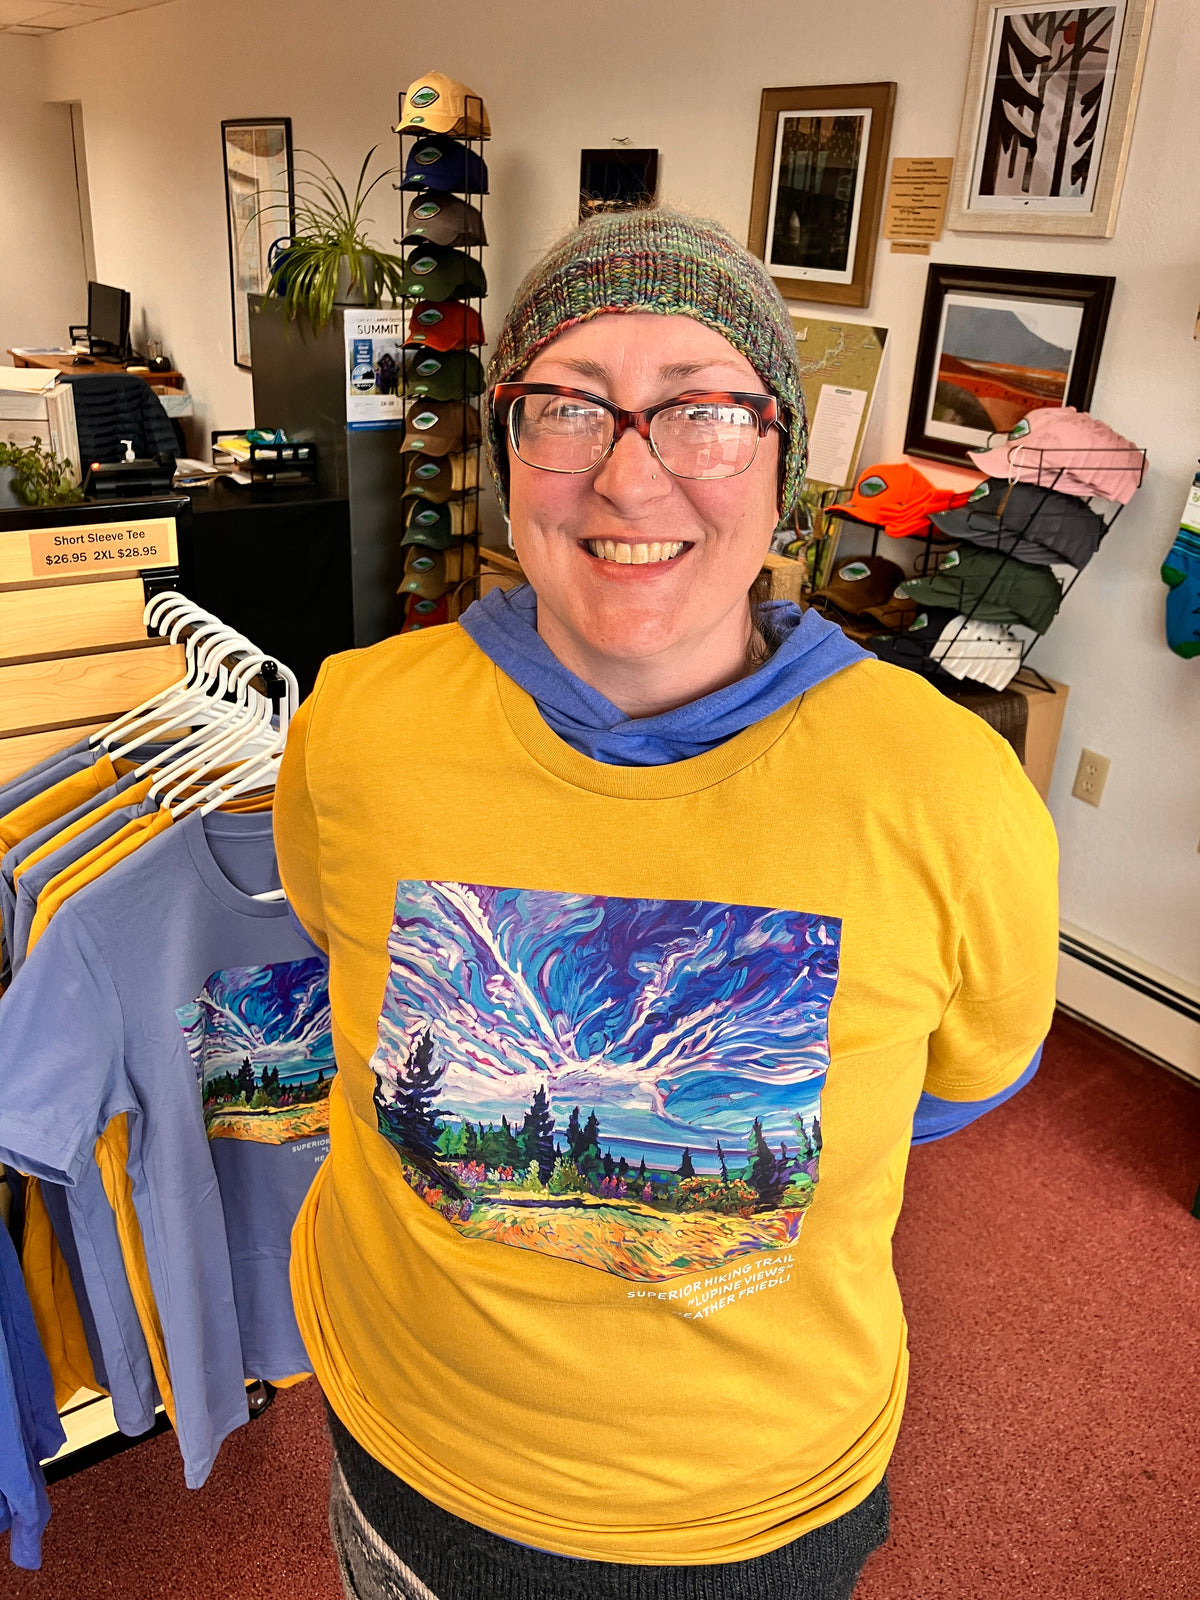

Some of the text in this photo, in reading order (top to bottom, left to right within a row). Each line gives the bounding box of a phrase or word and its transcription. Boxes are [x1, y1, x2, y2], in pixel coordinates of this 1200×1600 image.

[357, 324, 399, 334] SUMMIT
[54, 530, 145, 546] Short Sleeve Tee
[45, 545, 157, 566] $26.95 2XL $28.95
[292, 1138, 330, 1153] SUPERIOR
[627, 1254, 795, 1300] SUPERIOR HIKING TRAIL
[672, 1274, 791, 1319] EATHER FRIEDLI
